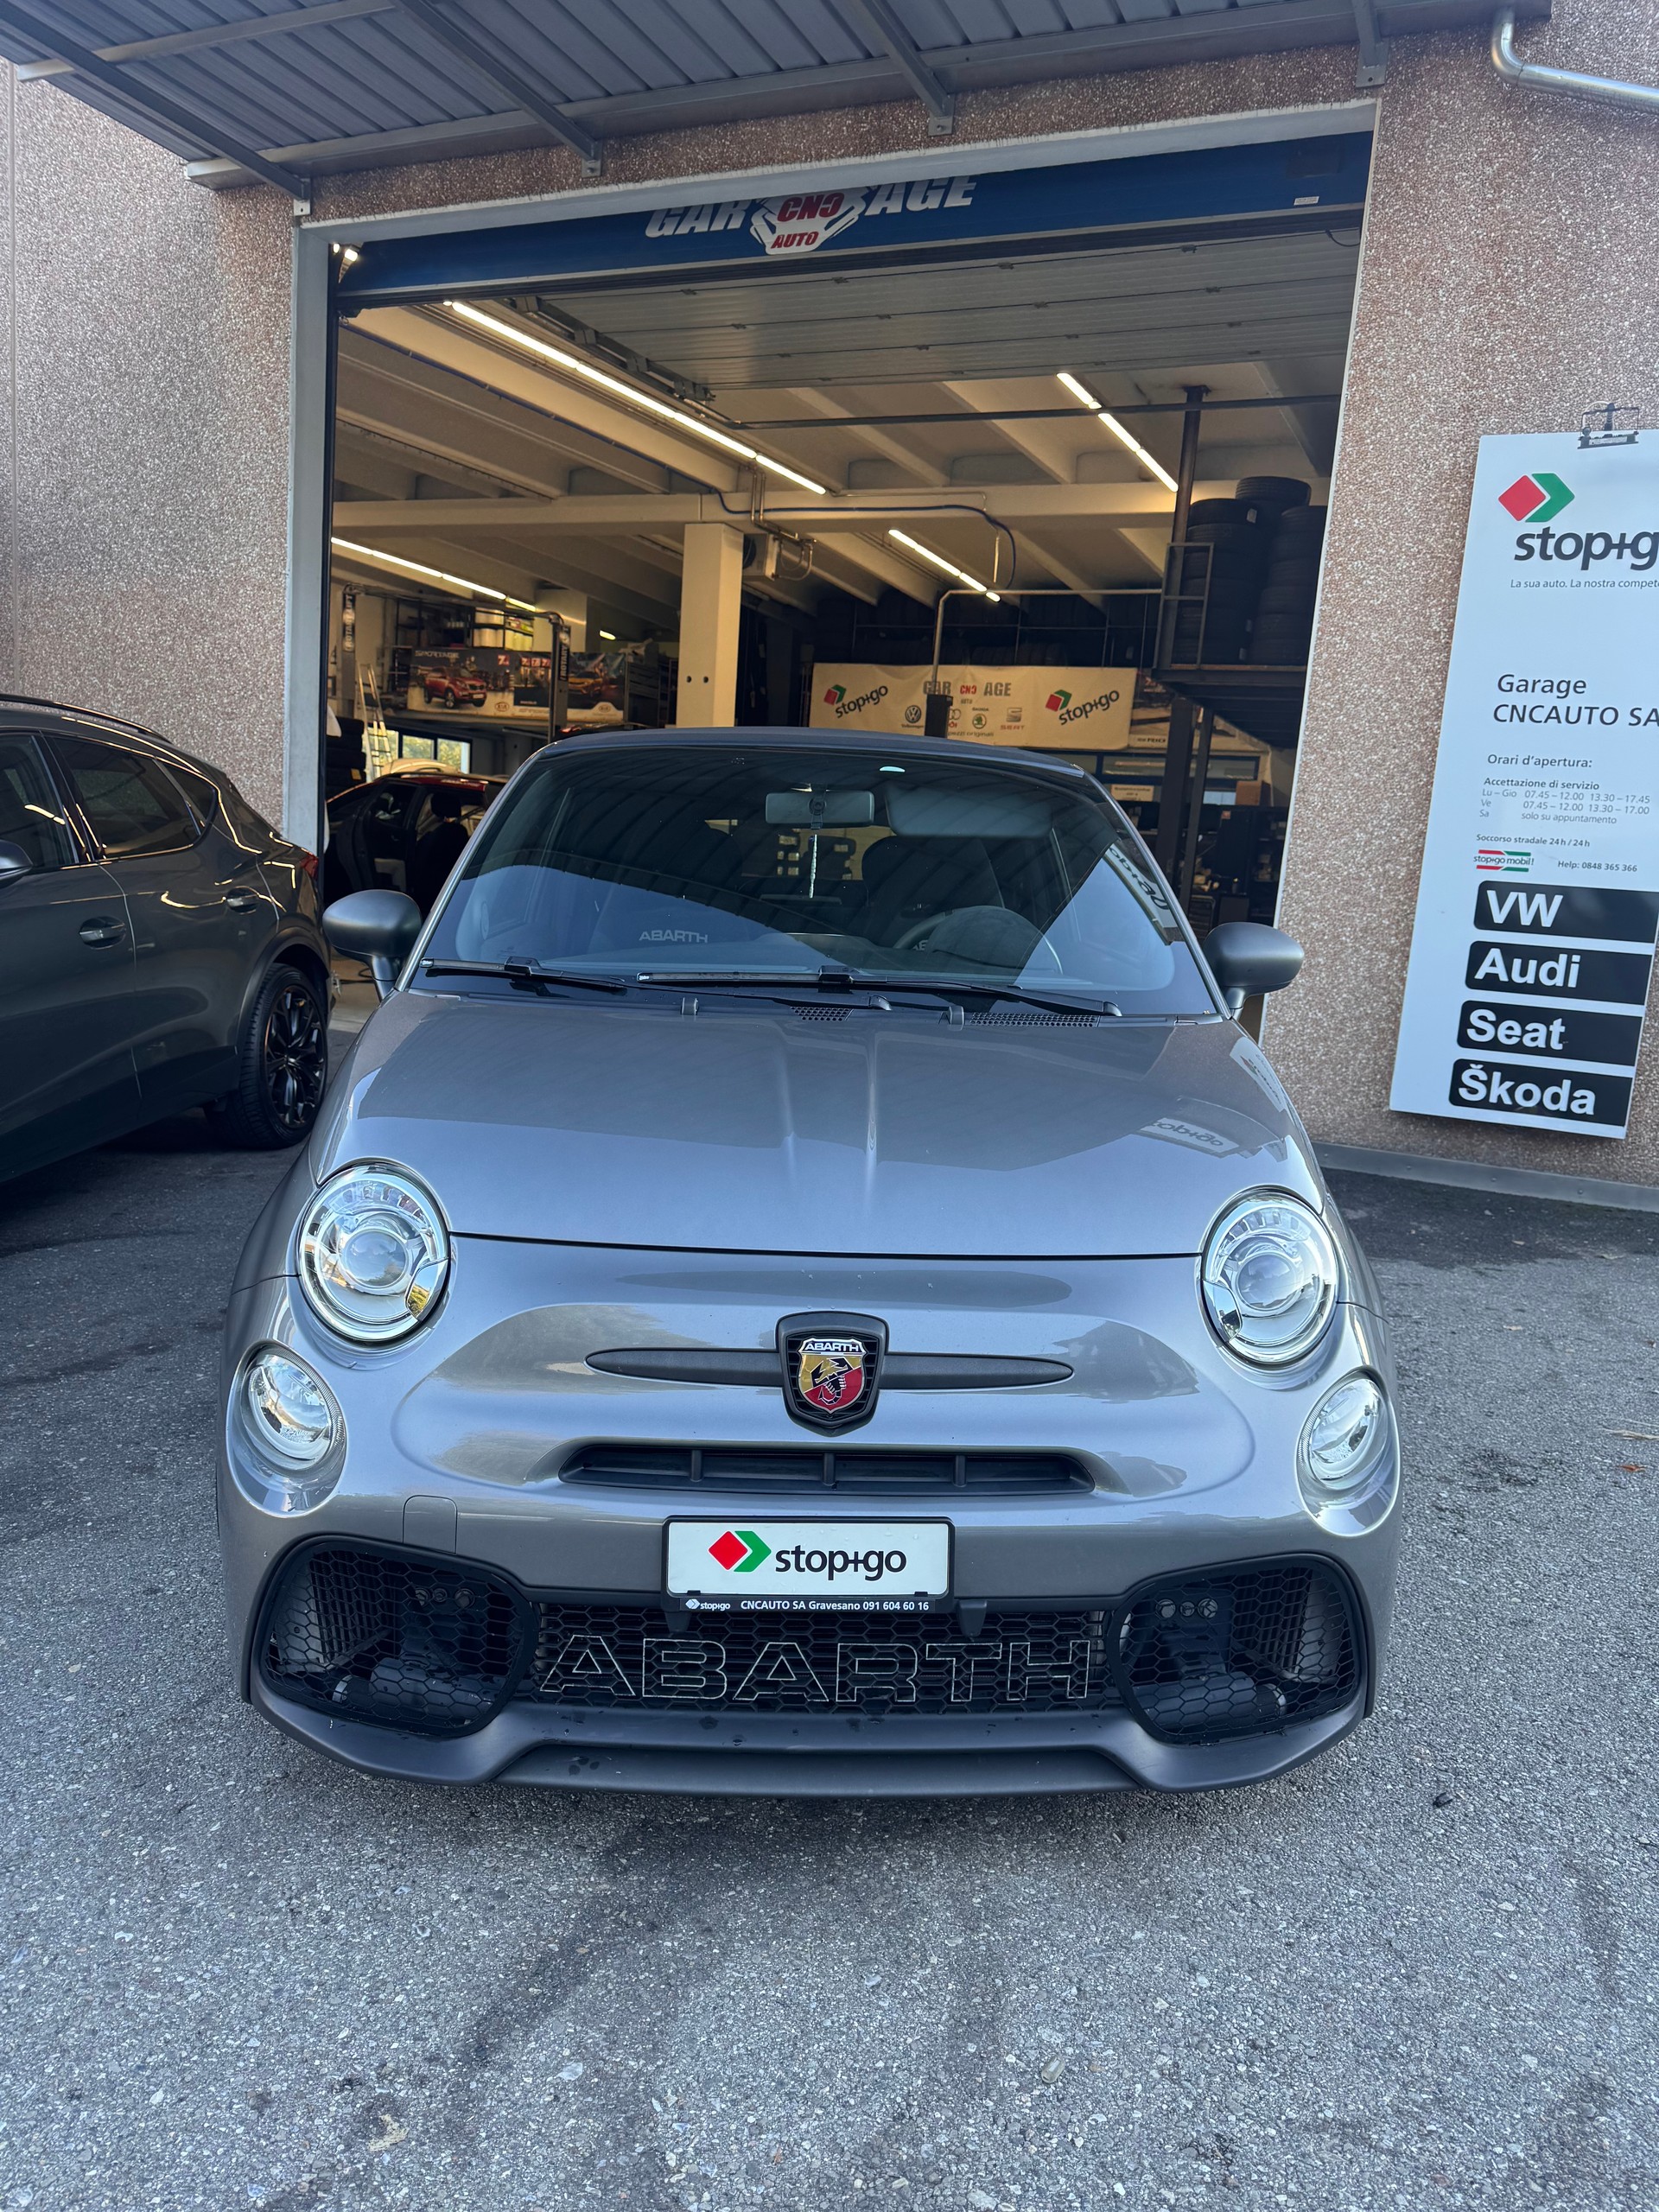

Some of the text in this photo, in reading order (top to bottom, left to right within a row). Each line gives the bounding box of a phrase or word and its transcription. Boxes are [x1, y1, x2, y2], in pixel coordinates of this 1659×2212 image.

[771, 231, 819, 249] AUTO
[1510, 579, 1521, 588] La
[1570, 579, 1582, 588] La
[983, 683, 1011, 696] AGE
[1497, 674, 1586, 699] Garage
[835, 684, 888, 719] stop+go
[1058, 689, 1120, 726] stop+go
[1493, 704, 1659, 727] CNCAUTO SA
[1487, 754, 1518, 765] Orari
[1484, 778, 1599, 791] Accettazione di servizio
[1524, 790, 1549, 798] 07.45
[1560, 791, 1584, 800] 12.00
[1590, 793, 1615, 802] 13.30
[1625, 795, 1650, 804] 17.45
[1523, 800, 1548, 810] 07.45
[1559, 802, 1583, 810] 12.00
[1588, 804, 1613, 813] 13.30
[1624, 806, 1649, 815] 17.00
[1521, 811, 1539, 820] solo
[1553, 814, 1617, 824] appuntamento
[1477, 834, 1511, 843] Soccorso
[1514, 835, 1548, 845] stradale
[1473, 855, 1505, 865] stop+go
[1558, 861, 1580, 870] Help:
[1582, 861, 1602, 870] 0848
[1622, 863, 1637, 872] 366
[1486, 890, 1563, 928] VW
[639, 929, 709, 944] ABARTH
[1474, 948, 1581, 988] Audi
[1467, 1009, 1566, 1051] Seat
[1458, 1063, 1596, 1116] Škoda
[804, 1343, 859, 1351] ABARTH
[775, 1545, 906, 1581] stop+go
[700, 1600, 929, 1611] stop+go CNCAUTO SA Gravesano 091 604 60 16
[539, 1634, 1090, 1702] ABARTH
